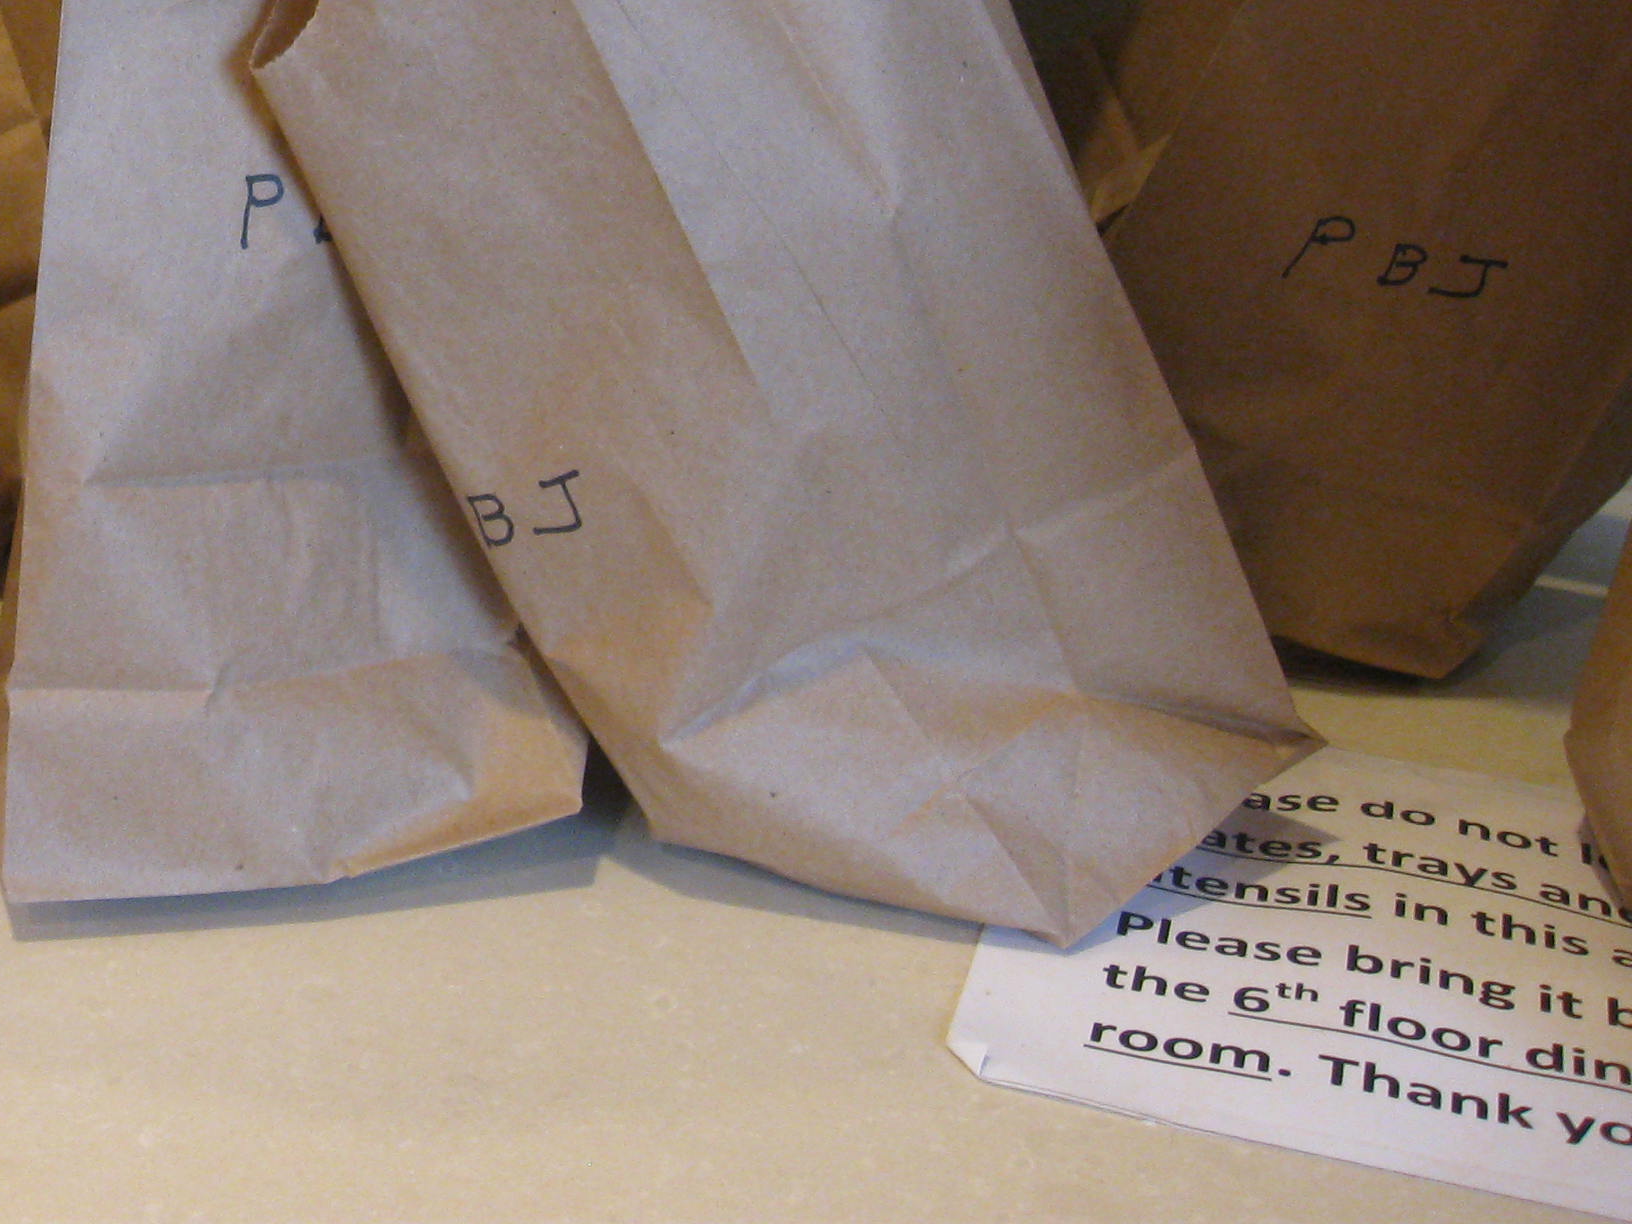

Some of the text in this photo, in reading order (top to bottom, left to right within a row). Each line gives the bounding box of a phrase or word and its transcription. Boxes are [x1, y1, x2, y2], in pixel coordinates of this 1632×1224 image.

[1360, 801, 1436, 826] do
[1458, 819, 1559, 857] not
[1362, 842, 1518, 891] trays
[1152, 865, 1371, 912] tensils
[1394, 892, 1449, 926] in
[1471, 911, 1589, 956] this
[1102, 964, 1211, 1003] the
[1233, 982, 1319, 1013] 6th
[1339, 999, 1503, 1058] floor
[1117, 911, 1323, 967] Please
[1346, 944, 1516, 1010] bring
[1539, 984, 1584, 1019] it
[1089, 1022, 1292, 1077] room.
[1318, 1053, 1534, 1130] Thank
